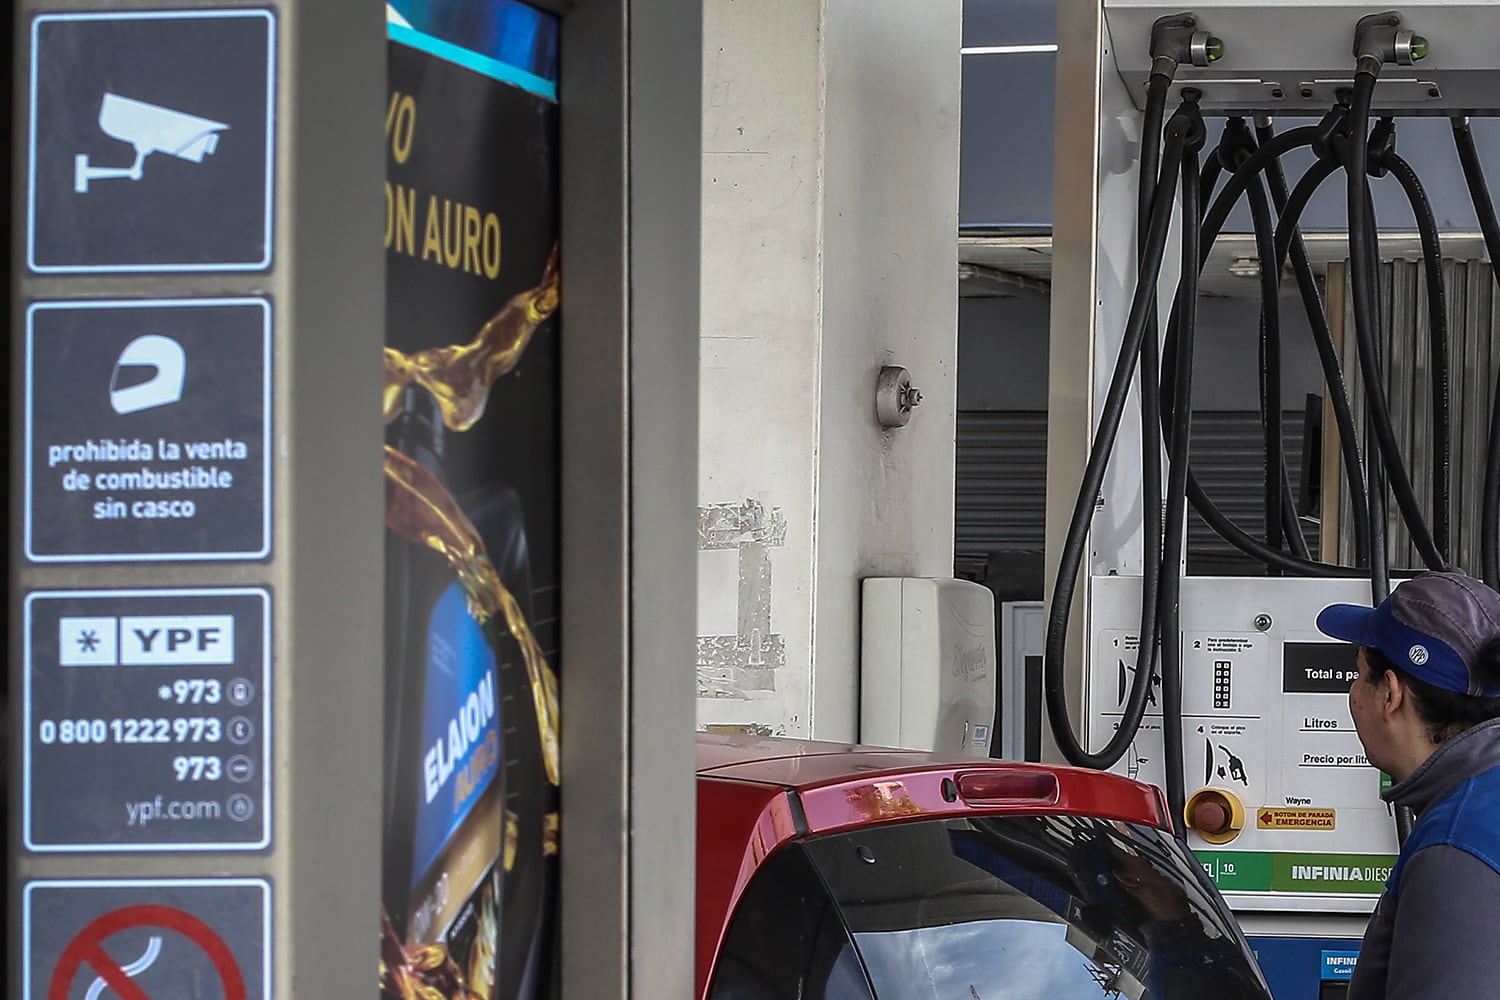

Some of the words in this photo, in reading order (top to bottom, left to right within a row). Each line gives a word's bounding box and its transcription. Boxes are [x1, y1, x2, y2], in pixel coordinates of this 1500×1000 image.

[422, 195, 501, 279] AURO
[49, 439, 153, 467] prohibida
[158, 438, 181, 460] la
[184, 438, 247, 460] venta
[62, 468, 90, 491] de
[95, 466, 233, 490] combustible
[93, 497, 127, 519] sin
[131, 500, 196, 518] casco
[134, 628, 220, 652] YPF
[1305, 668, 1333, 680] Total
[1335, 671, 1343, 680] a
[1304, 718, 1338, 728] Litros
[424, 669, 494, 804] ELAION
[173, 756, 221, 781] 973
[1303, 755, 1334, 764] Precio
[1337, 757, 1353, 766] por
[127, 795, 220, 826] ypf.com
[1286, 797, 1311, 806] Wayne
[1223, 864, 1235, 873] 10
[1326, 957, 1357, 966] INFINI
